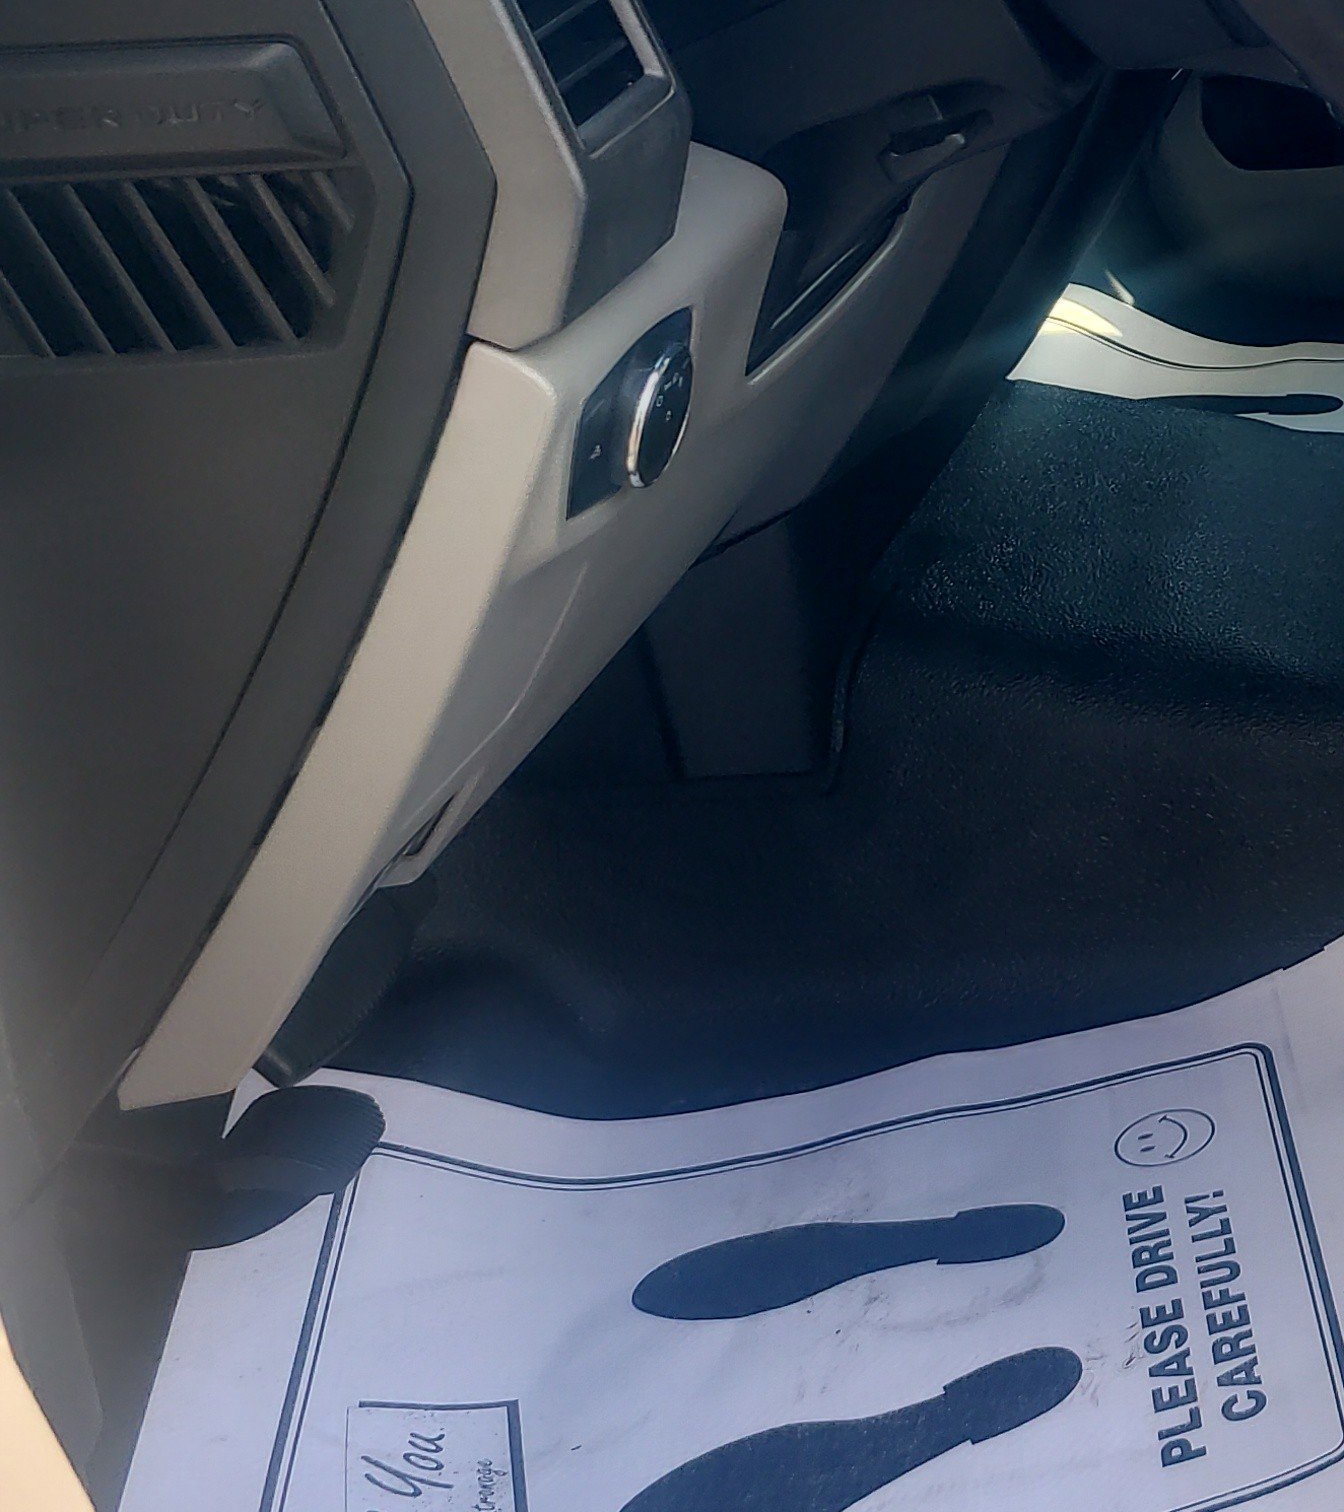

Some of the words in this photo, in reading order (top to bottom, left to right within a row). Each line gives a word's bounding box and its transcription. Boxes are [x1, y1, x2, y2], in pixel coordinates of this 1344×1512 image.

[1122, 1184, 1179, 1294] DRIVE
[1184, 1188, 1268, 1422] CAREFULLY!
[1139, 1297, 1207, 1468] PLEASE
[360, 1432, 455, 1497] You
